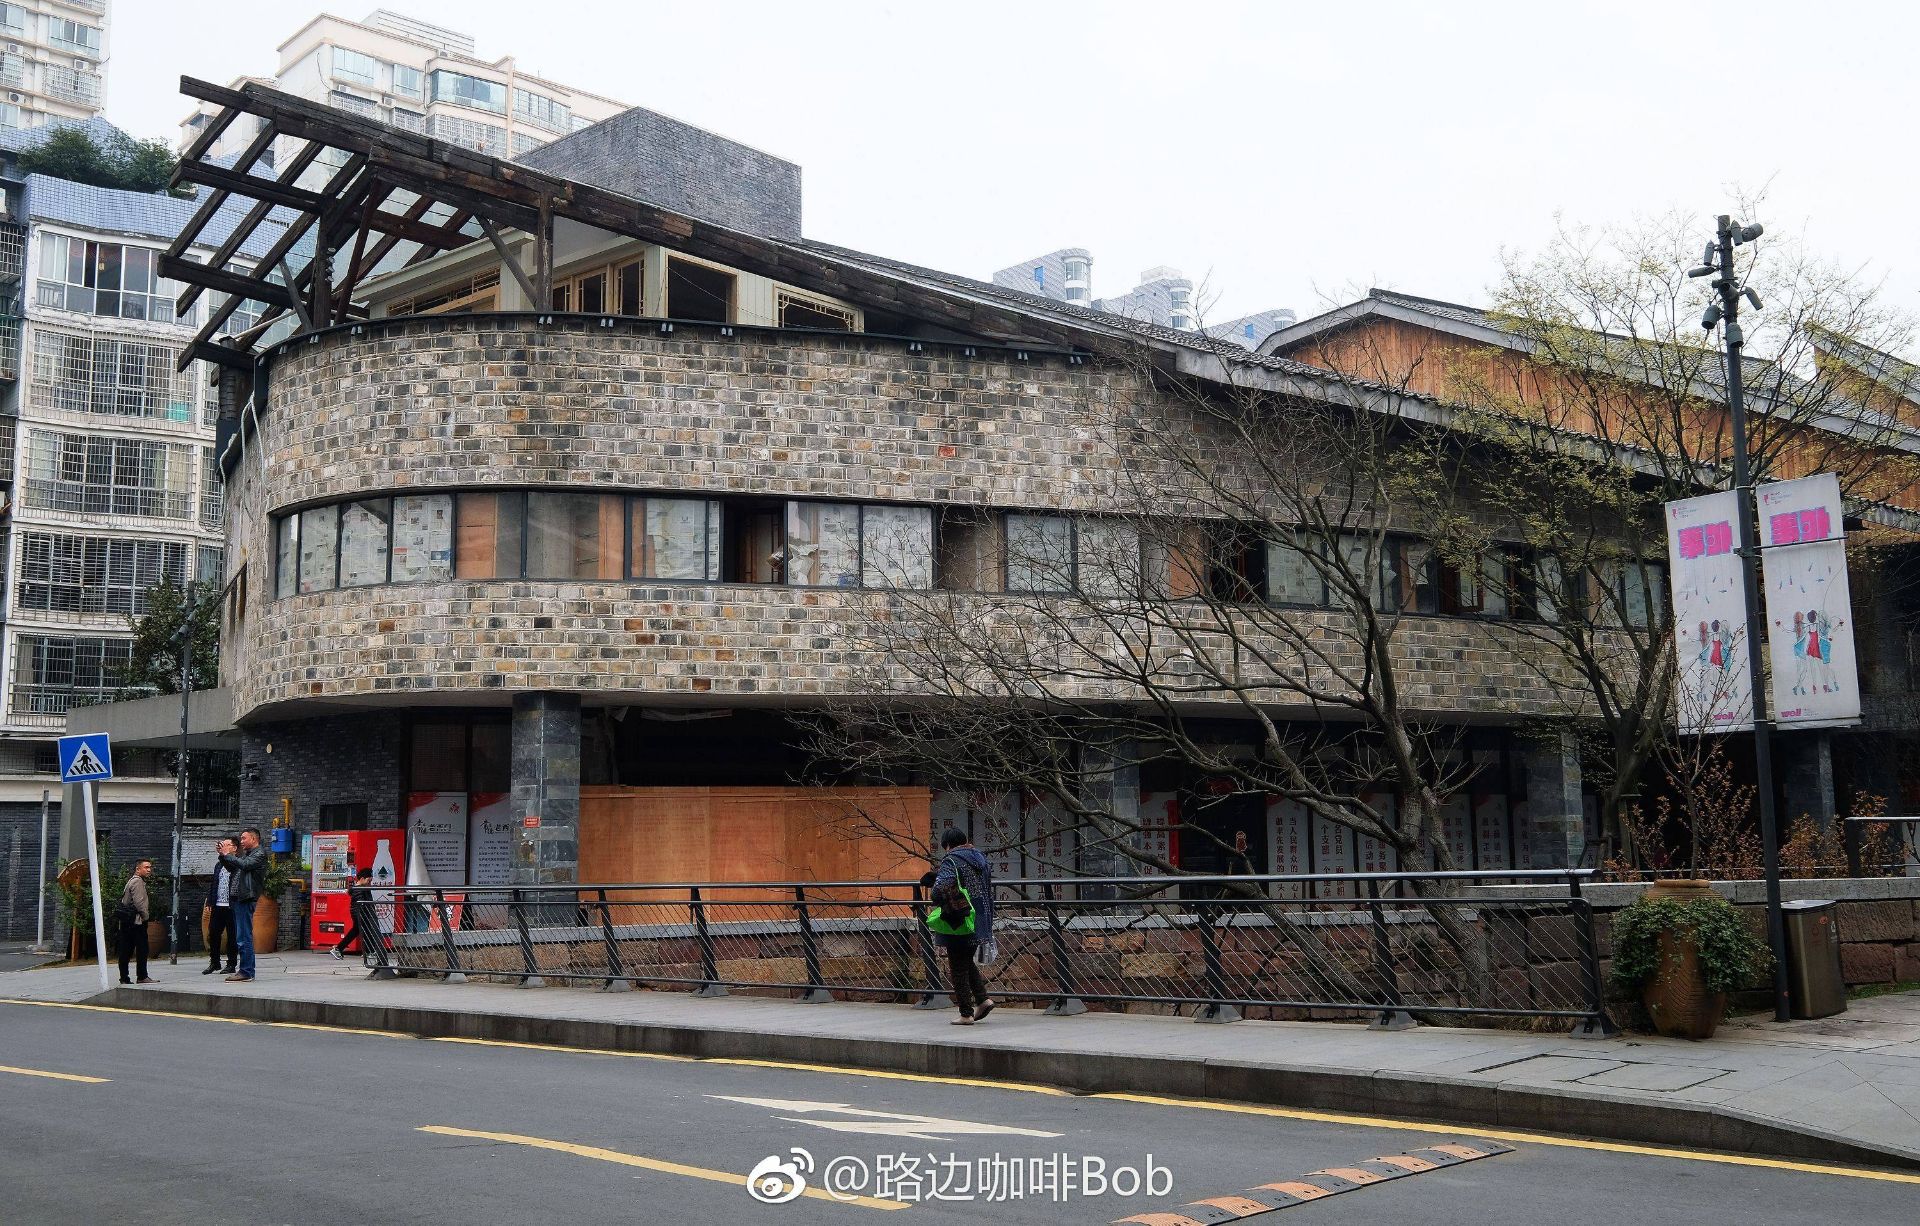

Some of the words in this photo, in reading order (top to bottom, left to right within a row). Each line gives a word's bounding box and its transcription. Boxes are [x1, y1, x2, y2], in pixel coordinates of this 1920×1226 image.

[1289, 816, 1299, 900] 当人民群众的心人
